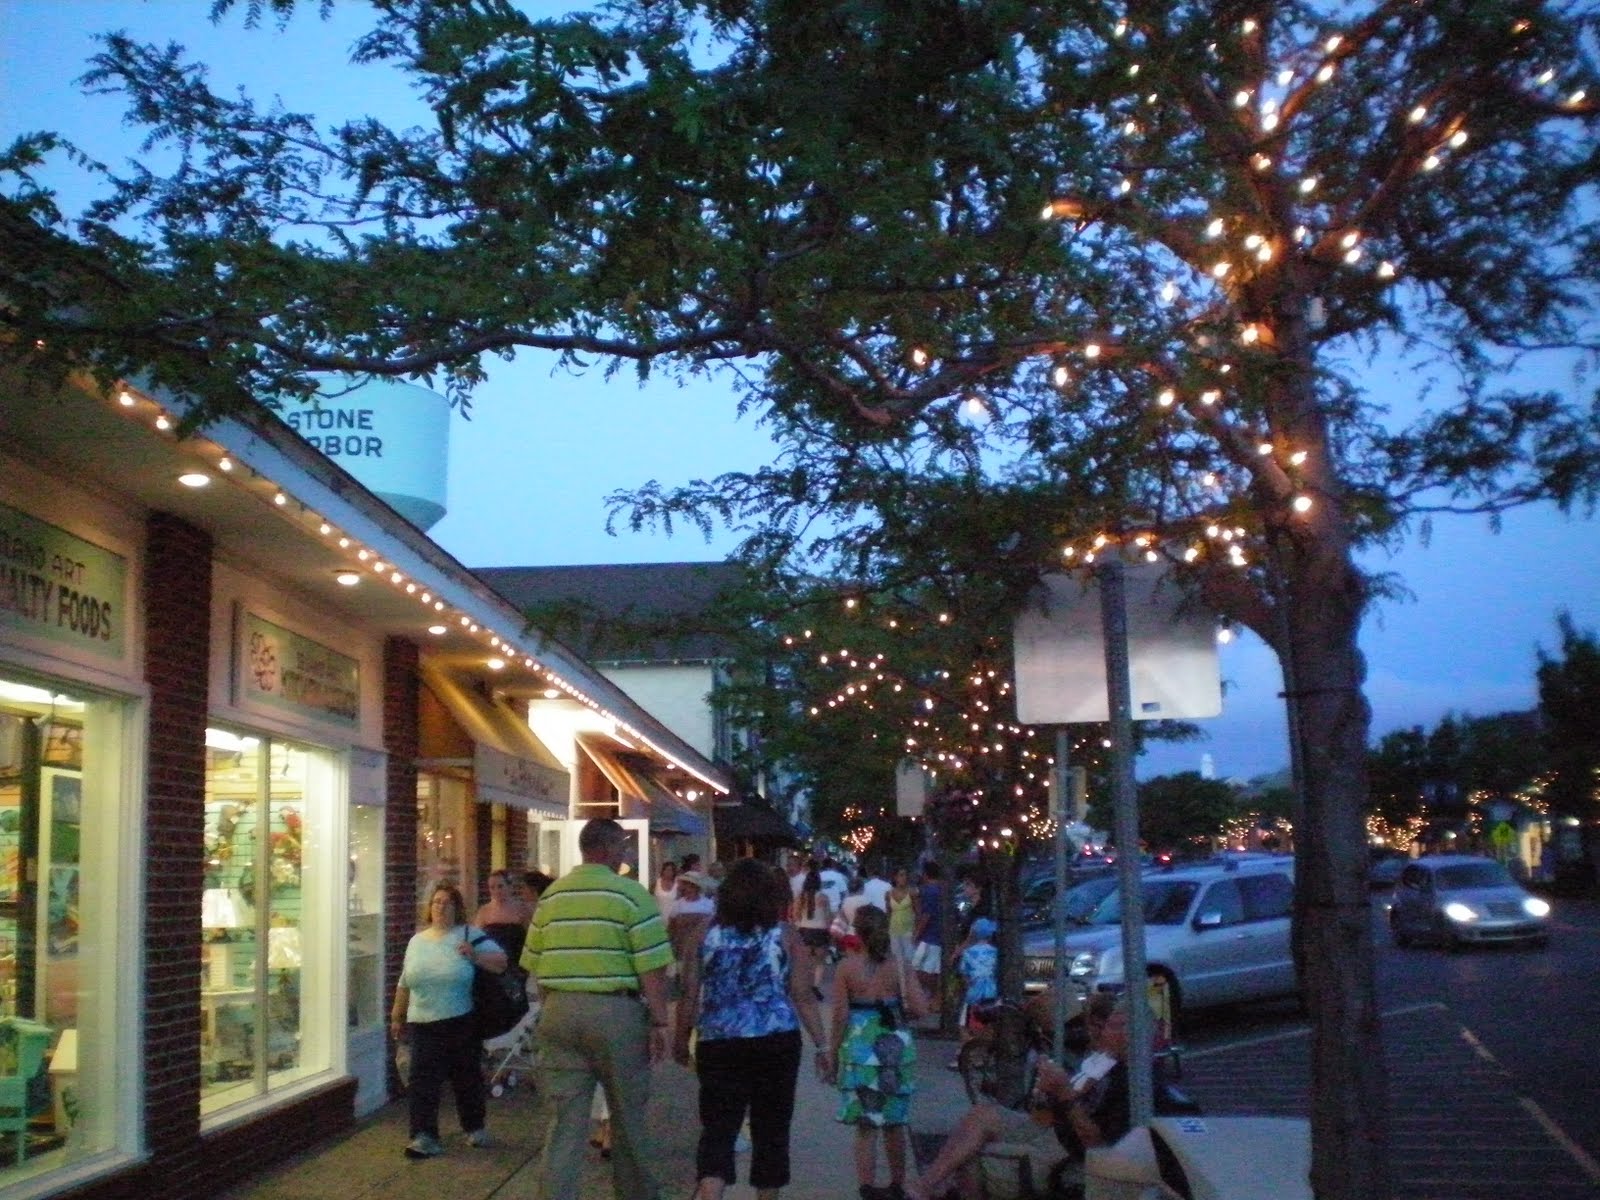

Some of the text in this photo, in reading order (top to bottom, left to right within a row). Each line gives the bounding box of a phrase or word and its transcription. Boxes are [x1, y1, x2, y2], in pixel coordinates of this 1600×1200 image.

[287, 408, 374, 431] STONE
[51, 554, 86, 585] ART
[58, 585, 112, 642] FOODS
